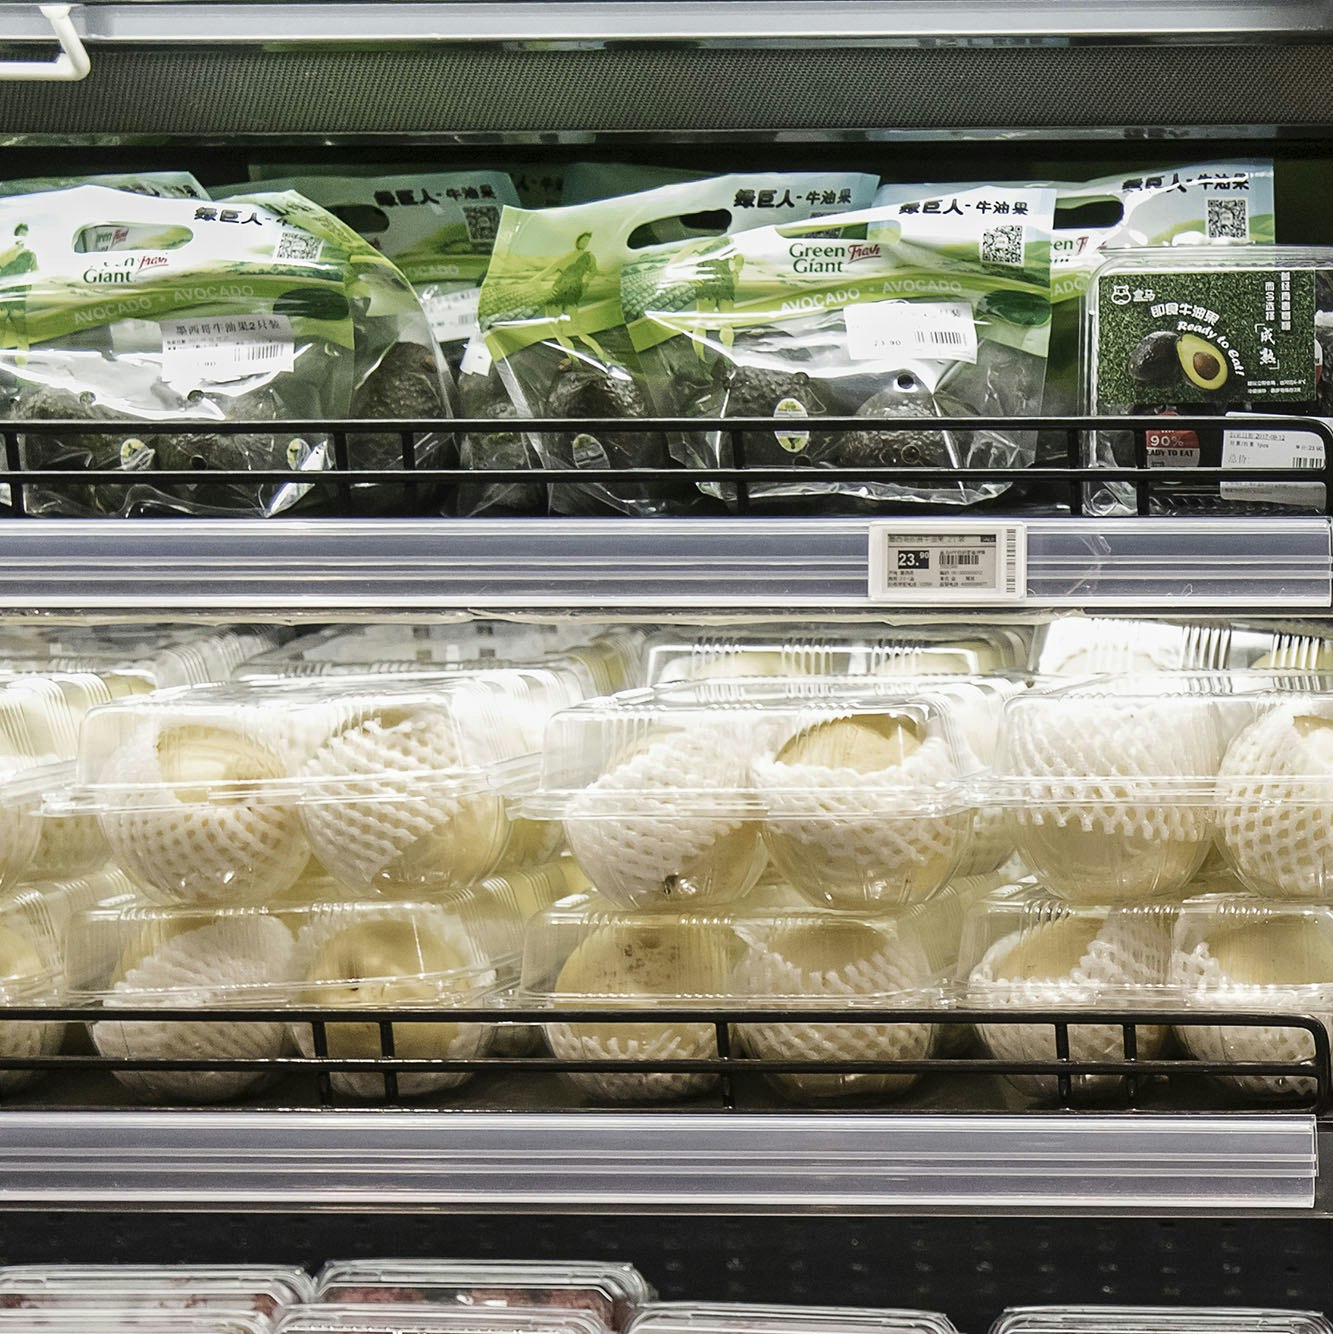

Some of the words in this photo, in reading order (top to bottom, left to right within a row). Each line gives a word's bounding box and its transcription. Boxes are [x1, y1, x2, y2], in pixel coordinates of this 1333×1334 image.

[789, 243, 845, 259] Green
[793, 259, 843, 274] Giant
[83, 268, 131, 284] Giant
[780, 287, 860, 312] AVOCADO
[883, 280, 962, 295] AVOCADO
[74, 296, 151, 325] AVOCADO
[174, 285, 255, 303] AVOCADO
[1150, 303, 1219, 325] 即食牛油果
[1177, 321, 1217, 338] Ready
[1216, 335, 1229, 349] to
[1150, 435, 1184, 447] 90%
[1179, 449, 1194, 458] EAT
[898, 552, 929, 566] 23.90
